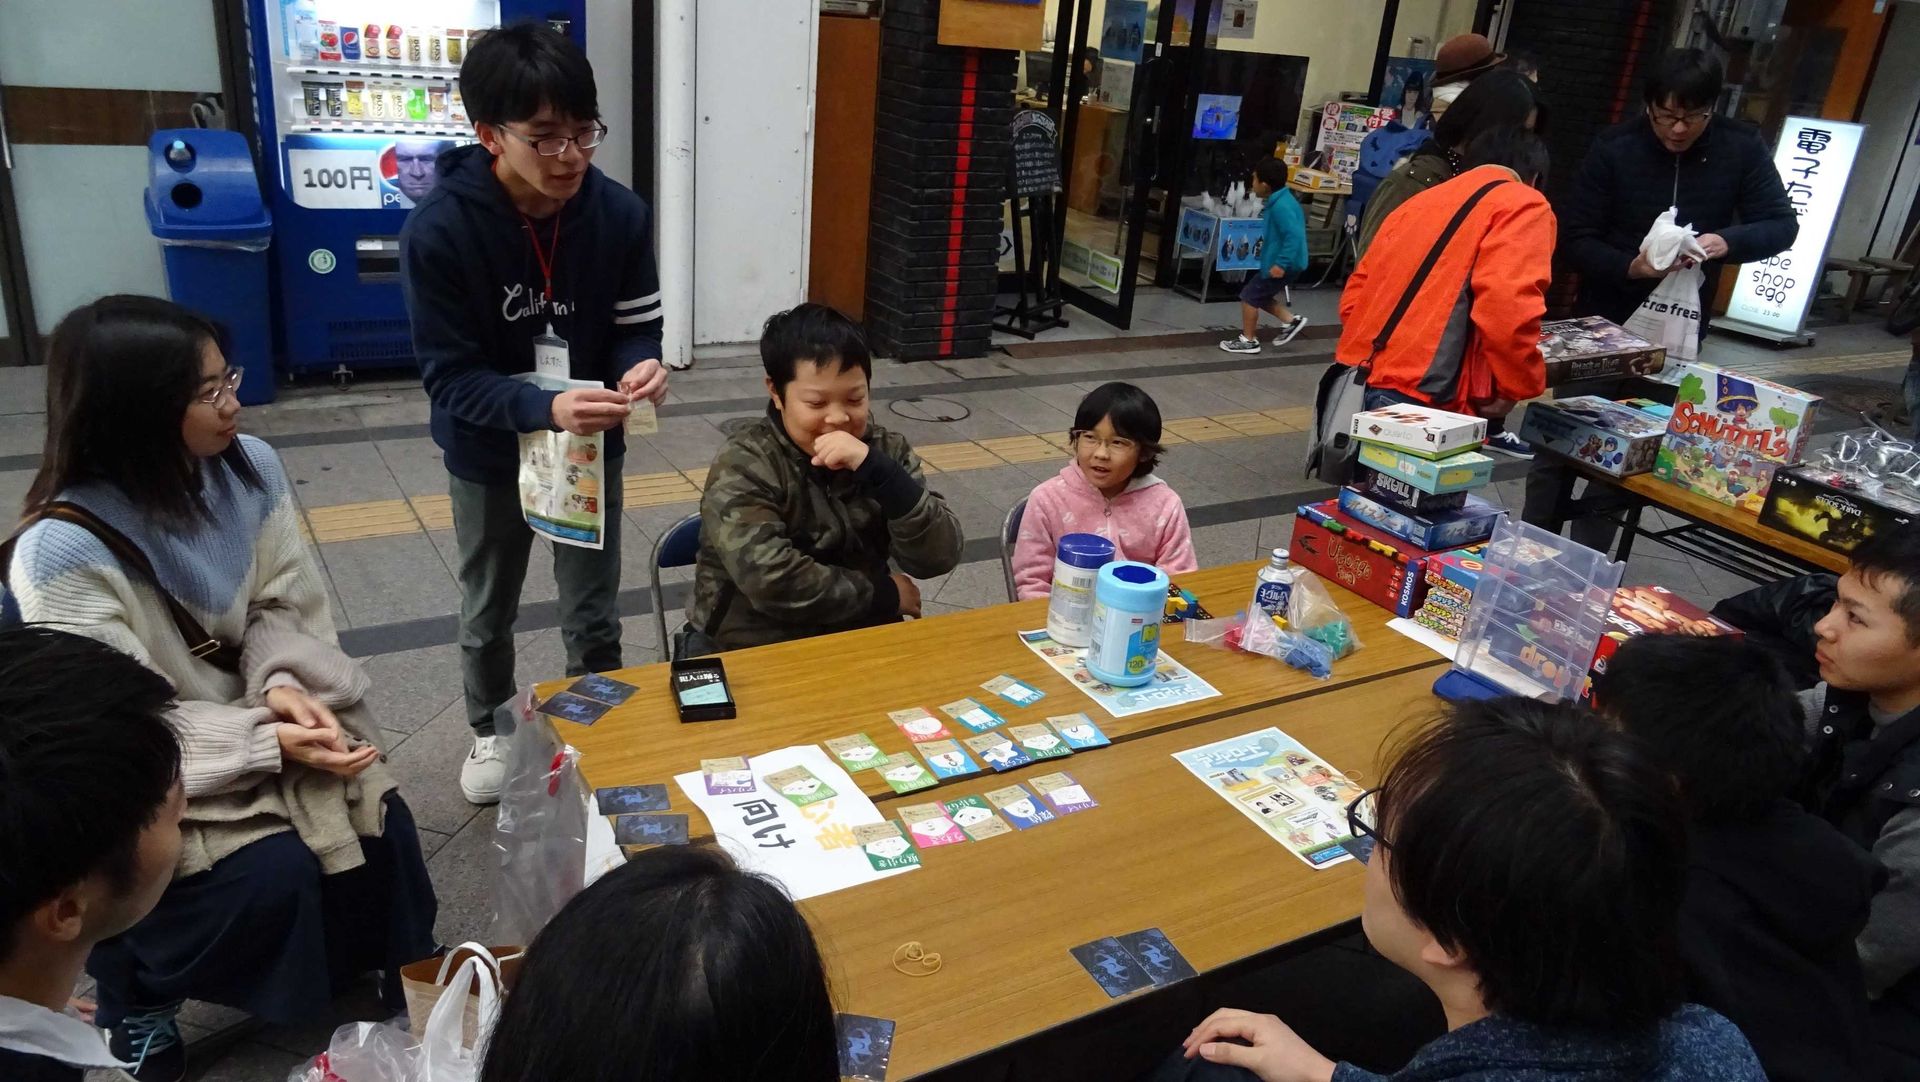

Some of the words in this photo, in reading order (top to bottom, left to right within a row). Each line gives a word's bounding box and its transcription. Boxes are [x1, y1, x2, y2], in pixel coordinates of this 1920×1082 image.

[303, 165, 374, 191] 100円
[383, 192, 401, 206] pe
[1759, 256, 1792, 271] ape
[1752, 269, 1795, 291] shop
[1755, 285, 1787, 305] ego
[1670, 303, 1700, 320] frea
[1376, 472, 1410, 500] SKULL
[1815, 495, 1840, 508] SOULS
[1839, 503, 1862, 517] DARK
[1400, 571, 1415, 606] KOSMOS
[733, 798, 796, 849] 向け
[1028, 809, 1054, 824] 探偵
[878, 853, 919, 868] 取り引き
